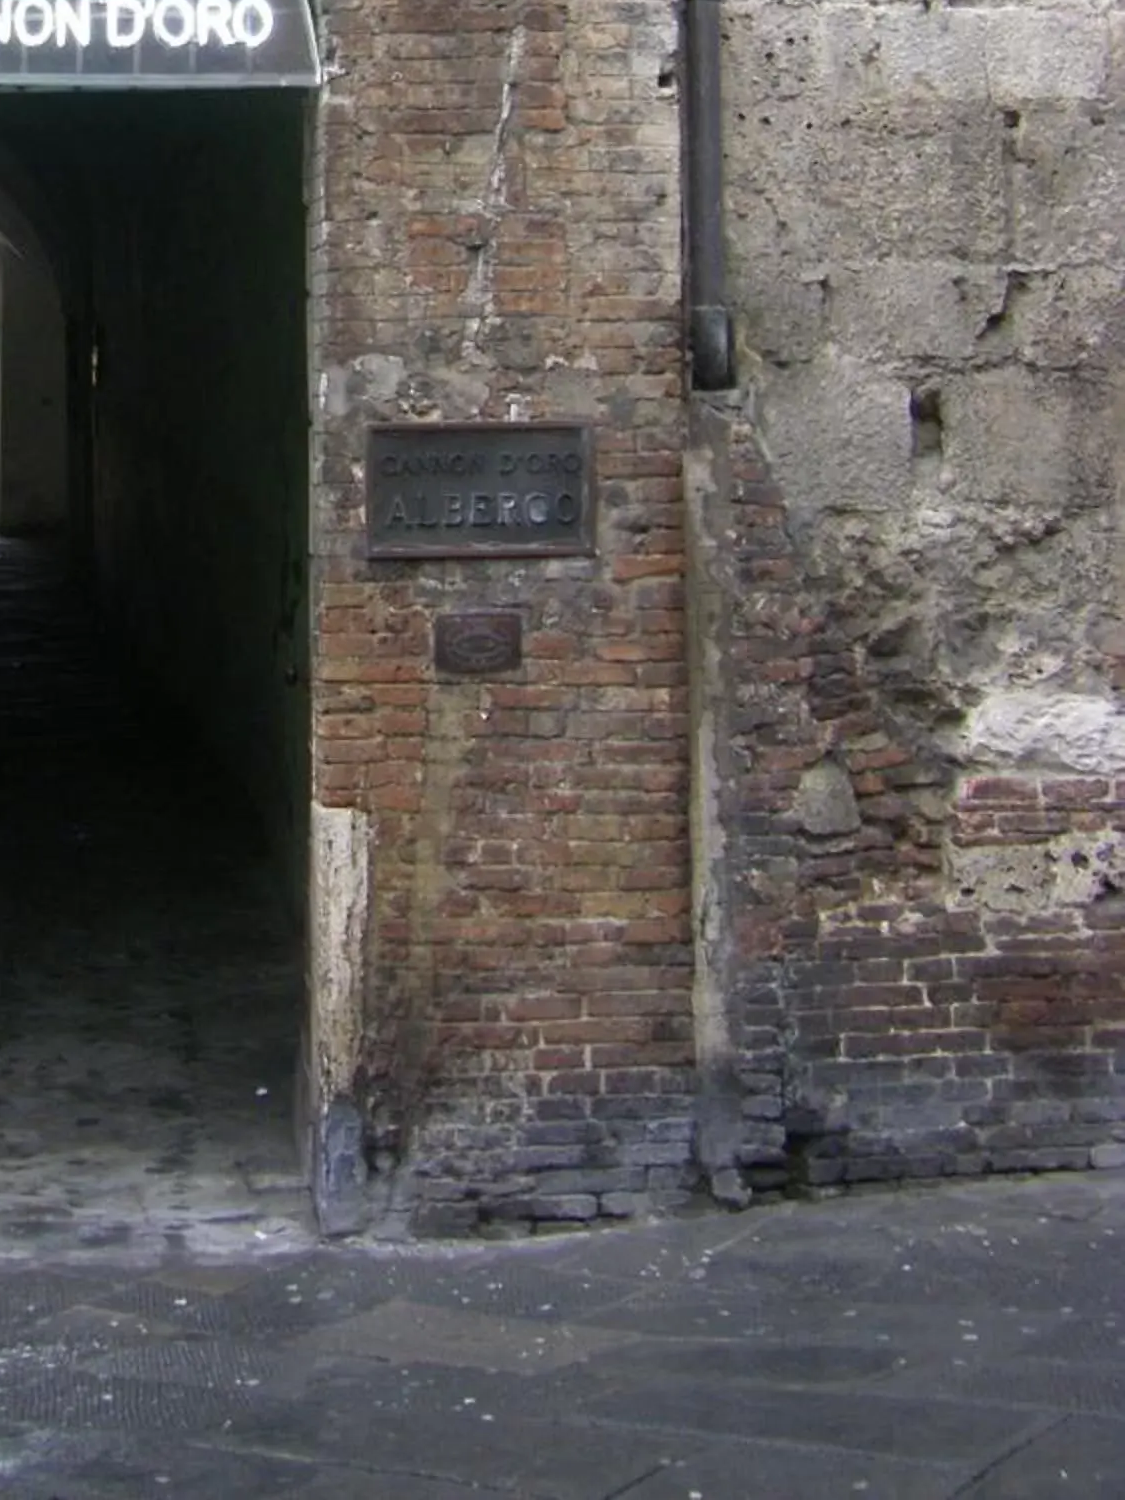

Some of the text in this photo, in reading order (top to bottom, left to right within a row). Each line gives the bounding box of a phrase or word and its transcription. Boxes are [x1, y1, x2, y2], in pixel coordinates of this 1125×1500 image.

[380, 452, 582, 477] CANNON D'ORO
[383, 491, 579, 528] ALBERGO
